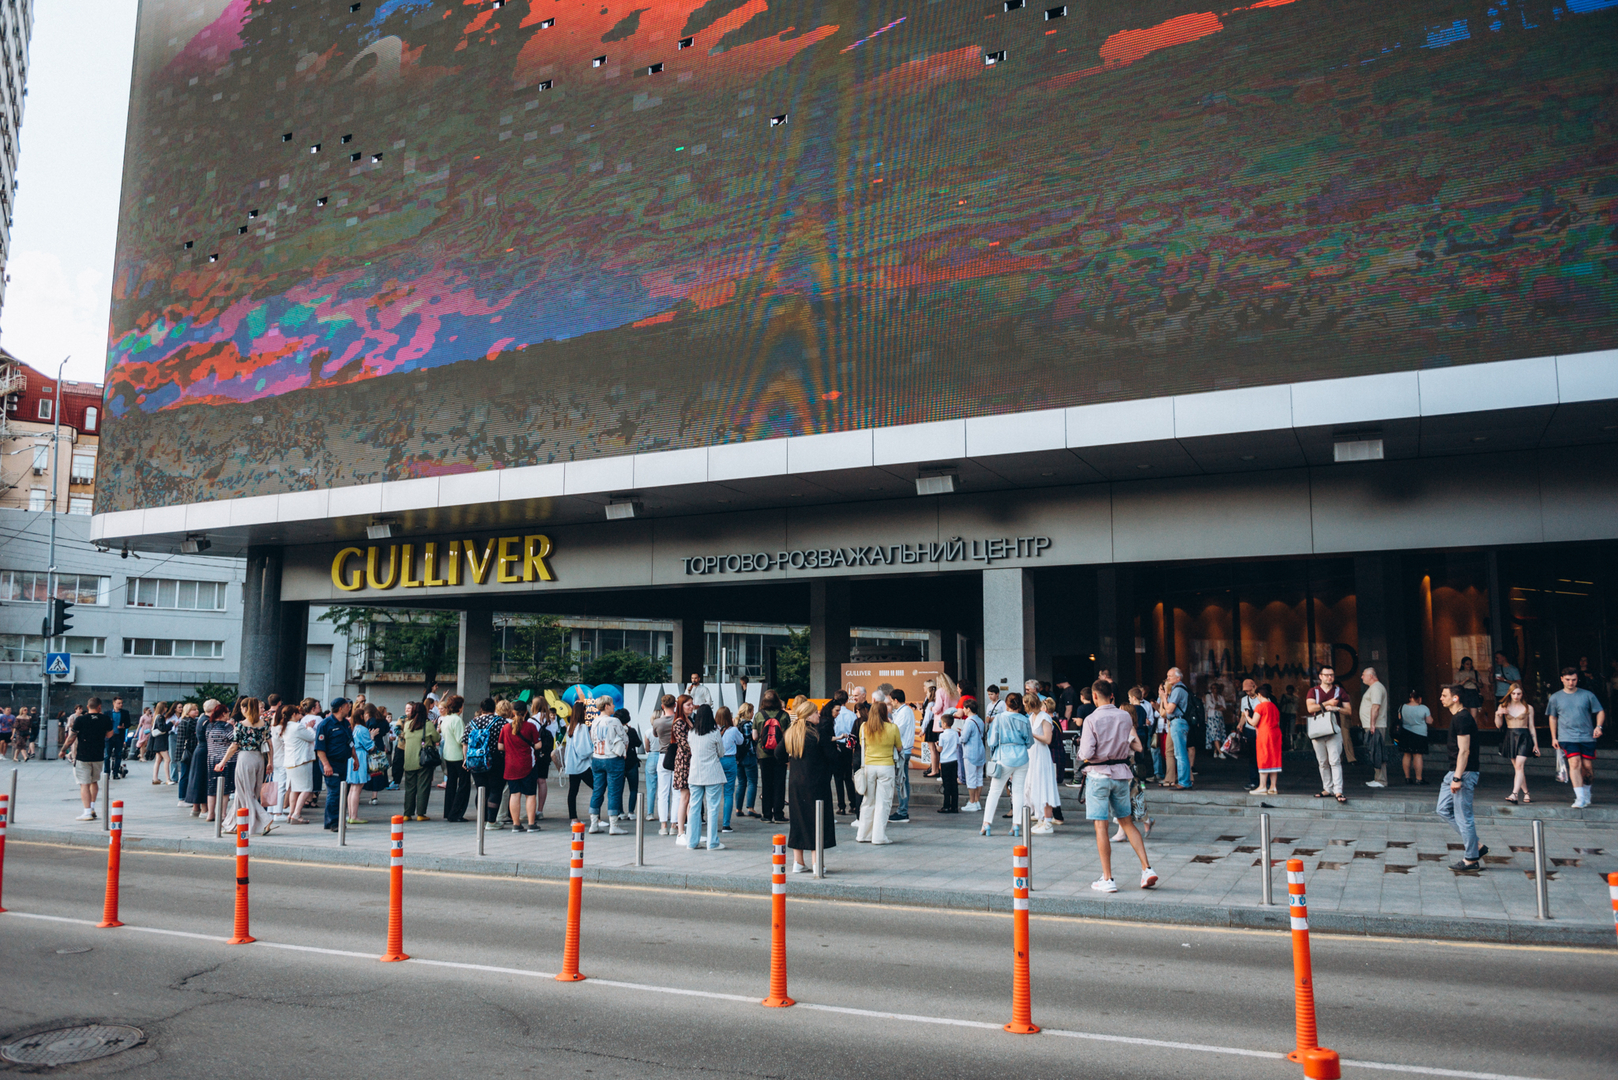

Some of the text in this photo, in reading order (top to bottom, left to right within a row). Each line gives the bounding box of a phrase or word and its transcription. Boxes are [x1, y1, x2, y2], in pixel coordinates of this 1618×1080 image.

[331, 534, 553, 591] GULLIVER
[681, 536, 1051, 575] ТОРГОВО-РОЗВАЖАЛЬНИЙ ЦЕНТР
[845, 669, 872, 677] GULLIVER
